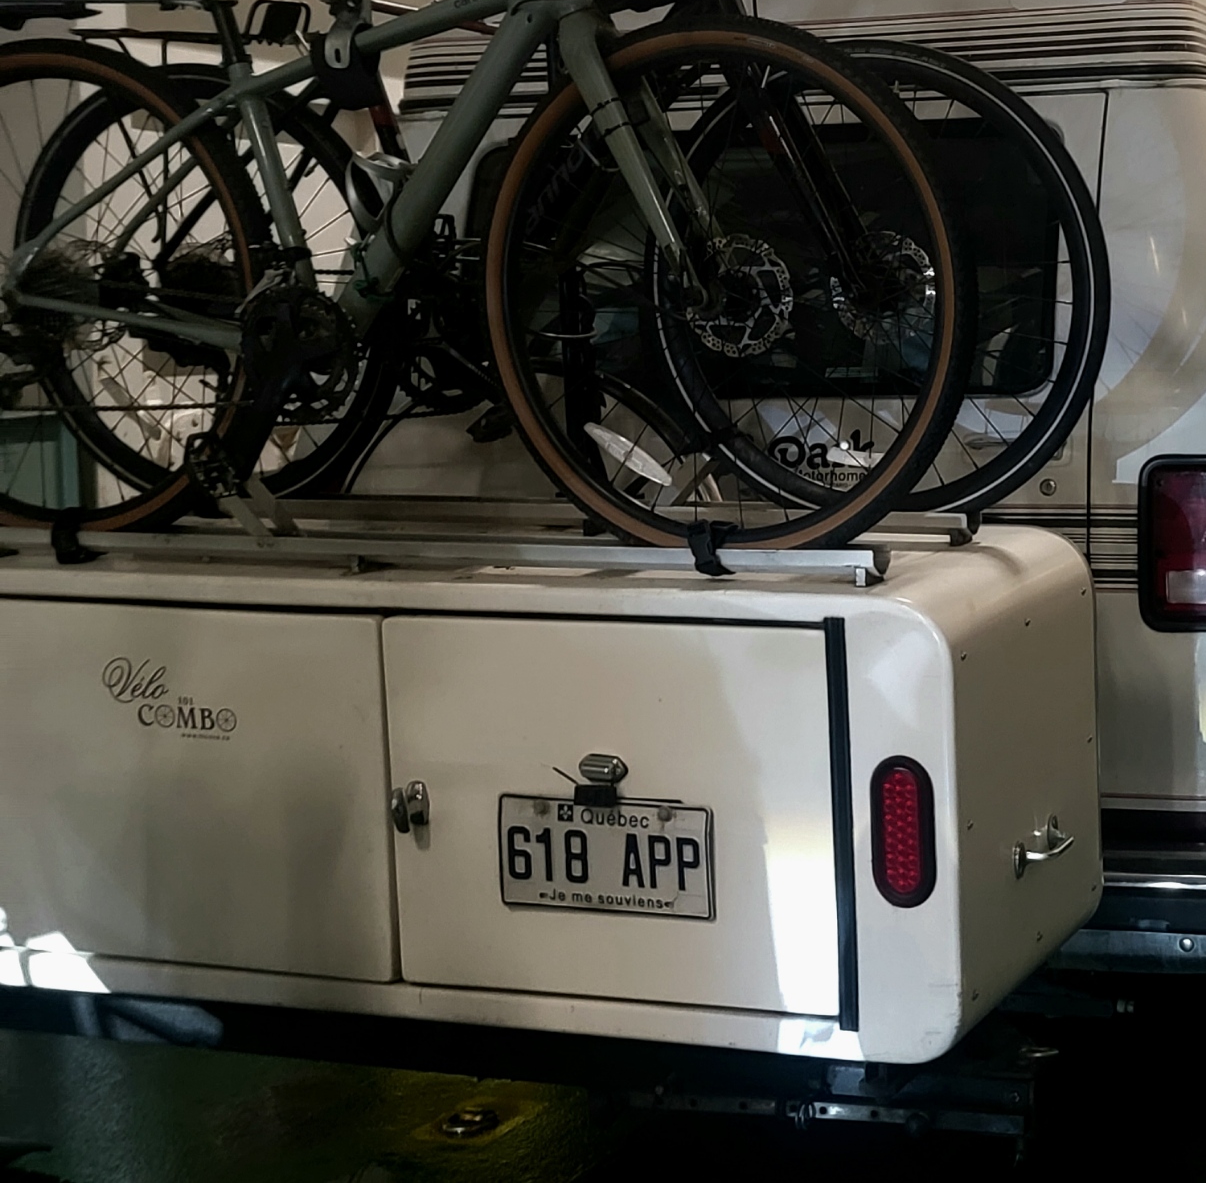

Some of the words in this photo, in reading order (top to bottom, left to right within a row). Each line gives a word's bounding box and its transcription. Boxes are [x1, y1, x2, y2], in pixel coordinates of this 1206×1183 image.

[799, 469, 867, 482] otorhome
[102, 657, 169, 703] Vélo
[137, 703, 238, 733] COMBO
[580, 808, 650, 829] Québec
[507, 825, 589, 884] 618
[622, 832, 700, 891] APP
[549, 888, 566, 901] Je
[572, 892, 592, 903] me
[598, 894, 664, 909] souviens
